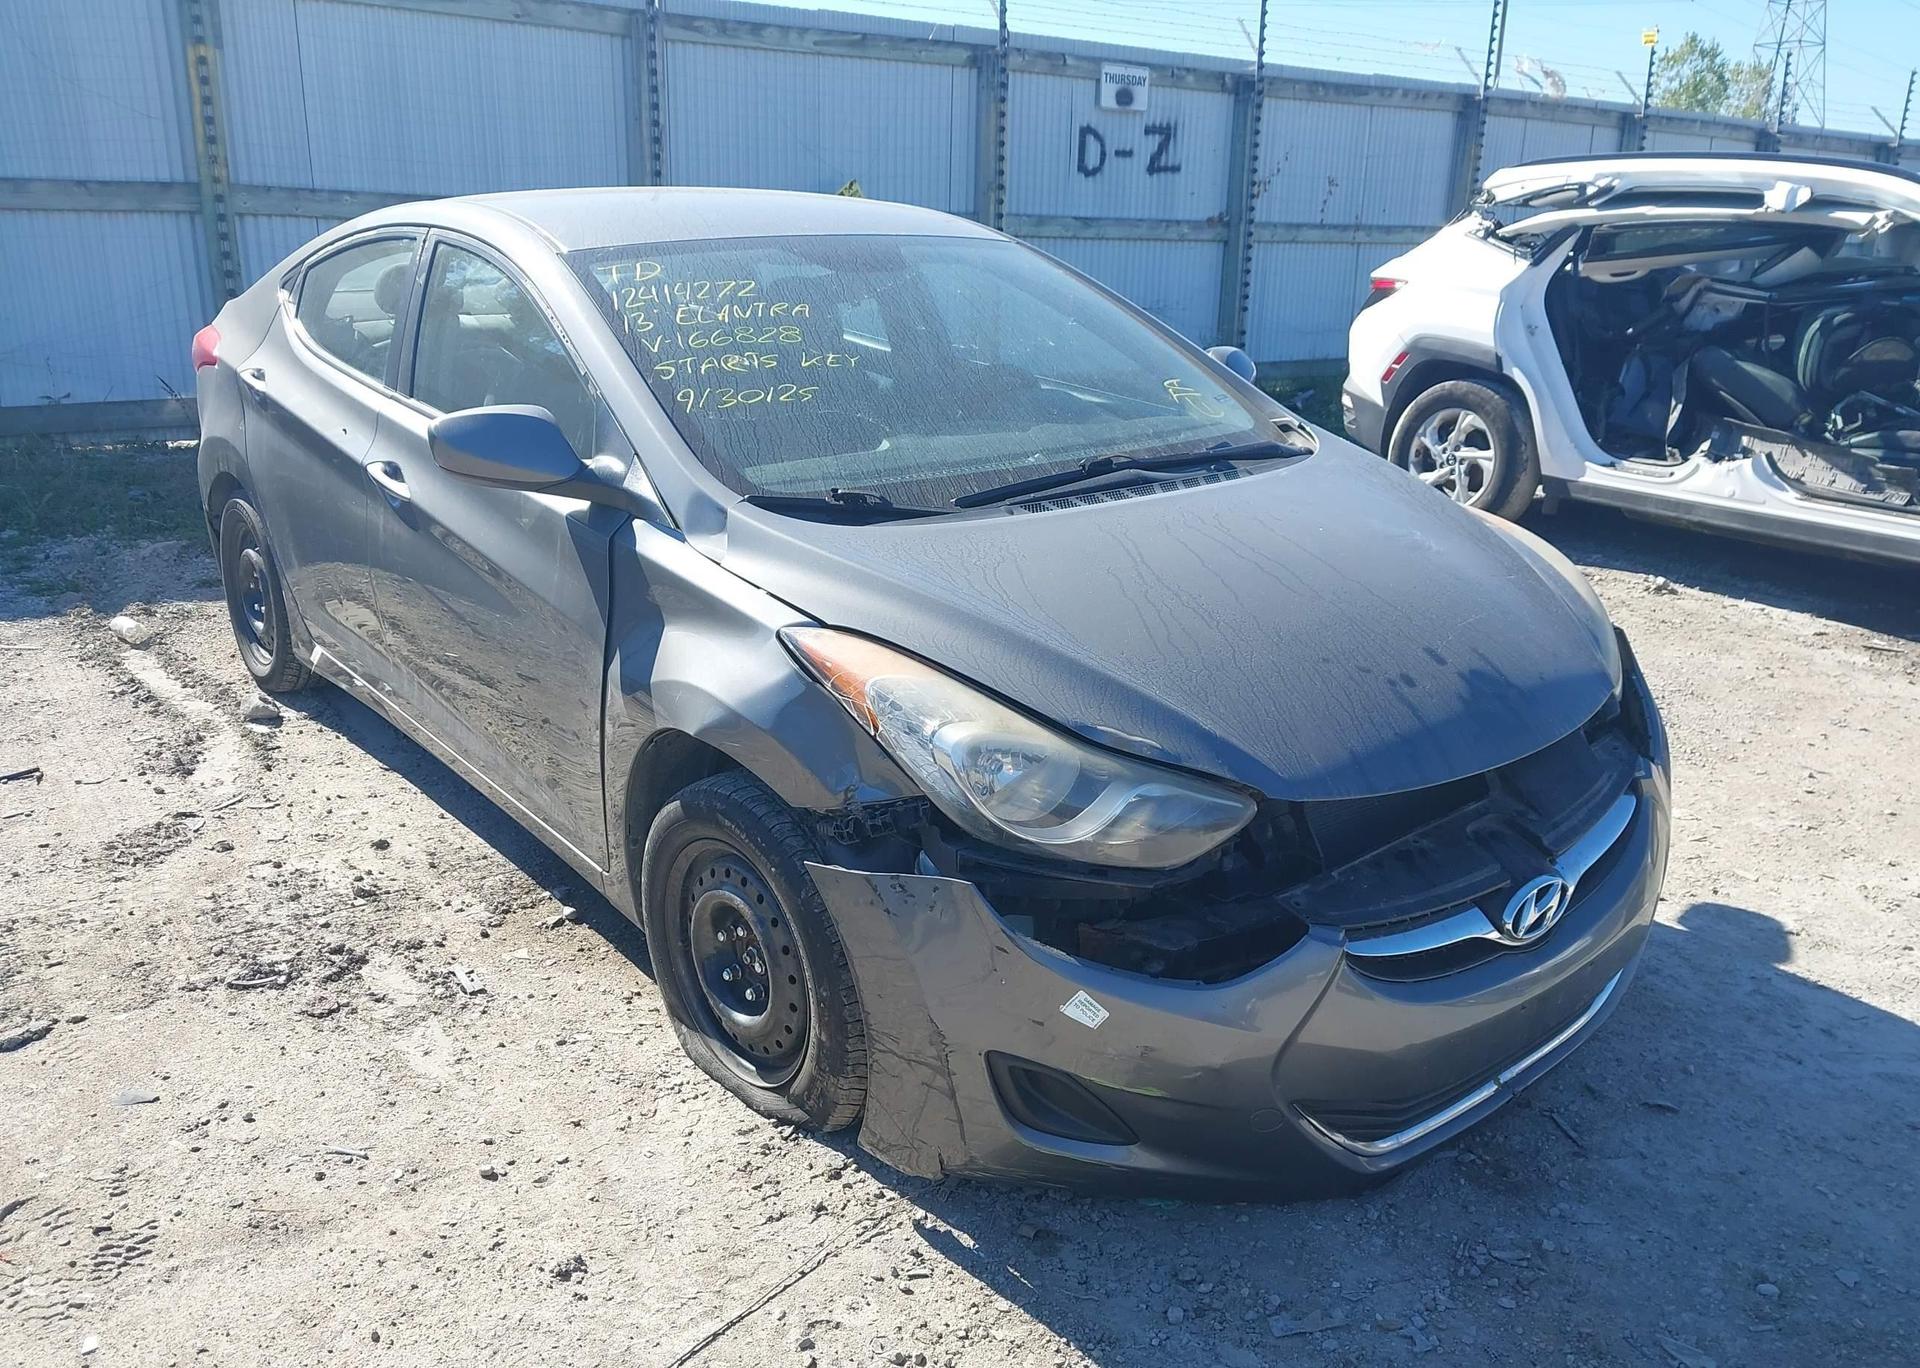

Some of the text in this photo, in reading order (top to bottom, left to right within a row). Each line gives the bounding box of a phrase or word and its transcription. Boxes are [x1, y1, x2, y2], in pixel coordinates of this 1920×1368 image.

[1103, 71, 1148, 87] THURSDAY
[598, 261, 661, 284] TD
[675, 302, 810, 325] ELANTRA
[641, 325, 802, 353] V-166828
[801, 351, 860, 368] KEY
[676, 383, 820, 414] 9/30/25
[1076, 999, 1100, 1019] REPORTED
[1083, 996, 1102, 1013] DAMAGE
[1079, 1007, 1096, 1023] POLICE
